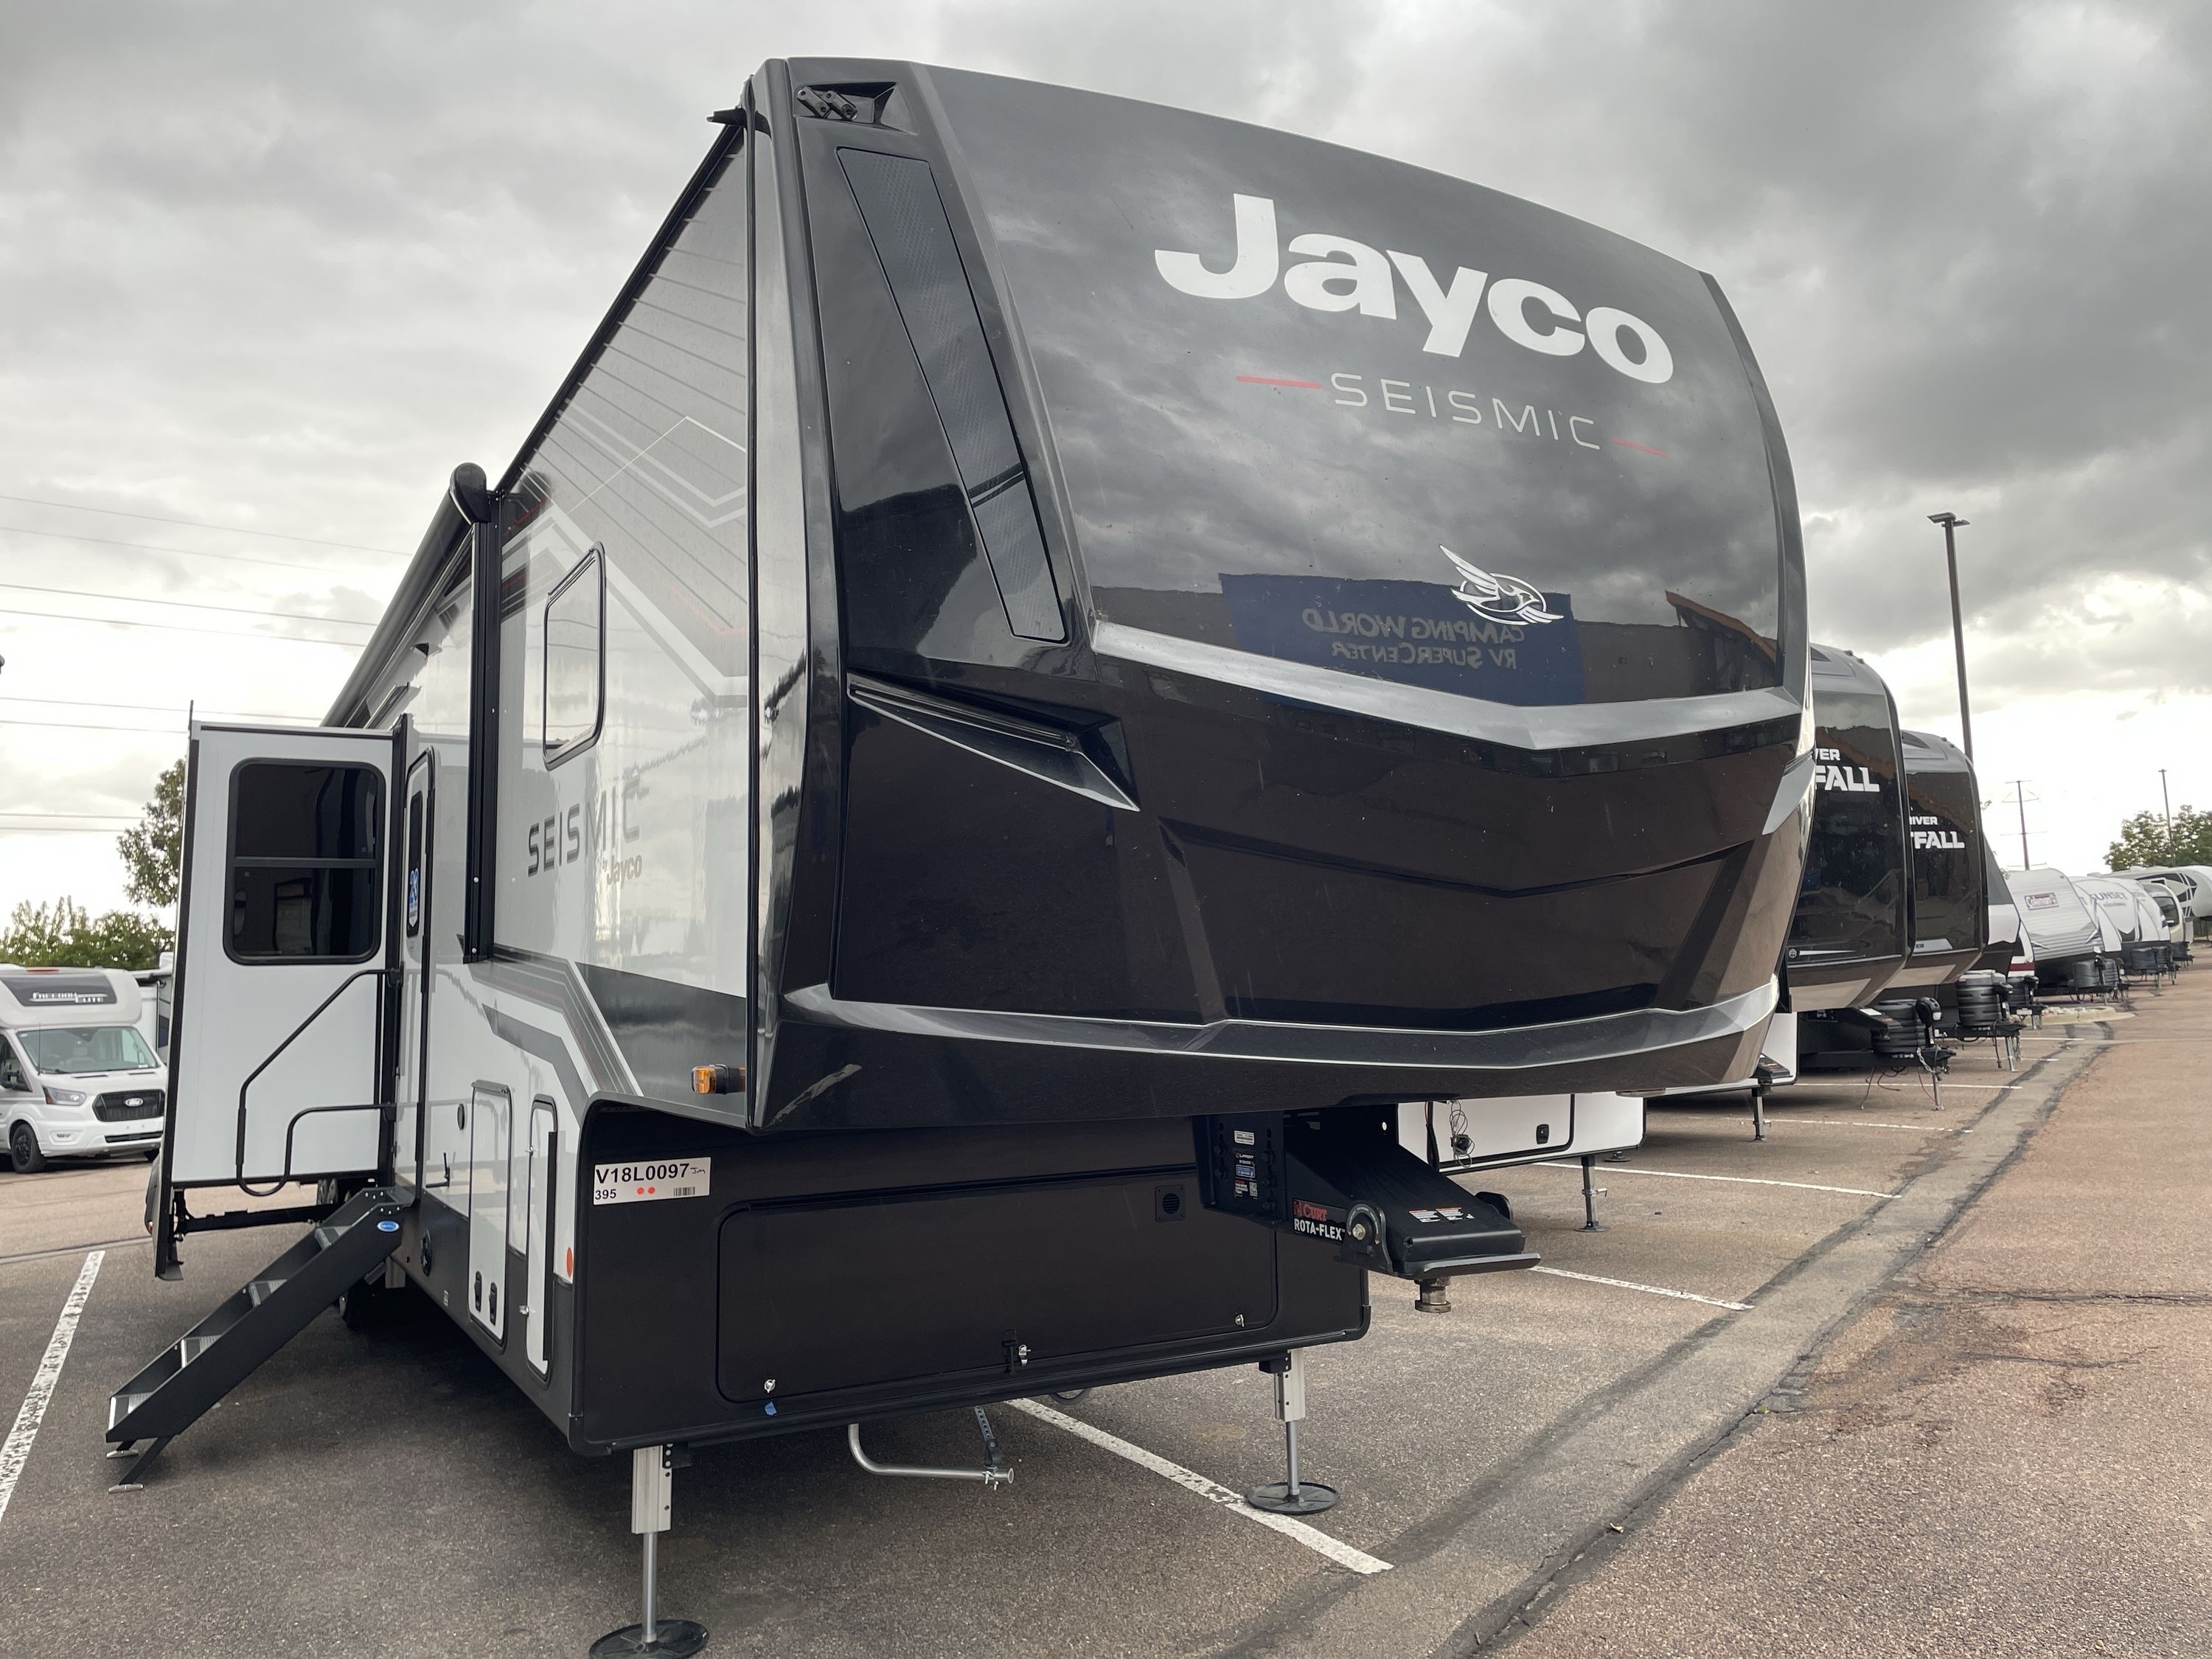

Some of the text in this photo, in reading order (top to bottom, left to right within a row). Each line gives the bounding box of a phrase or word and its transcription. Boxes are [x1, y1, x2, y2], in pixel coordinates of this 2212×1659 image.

[1154, 192, 1674, 384] Jayco
[1329, 372, 1601, 451] SEISMIC
[527, 776, 641, 878] SEISMIC
[1910, 831, 1965, 849] FALL
[606, 854, 643, 890] Jayco
[596, 1163, 690, 1184] V18L0097
[595, 1189, 617, 1200] 395
[1294, 1218, 1343, 1241] ROTA-FLEX
